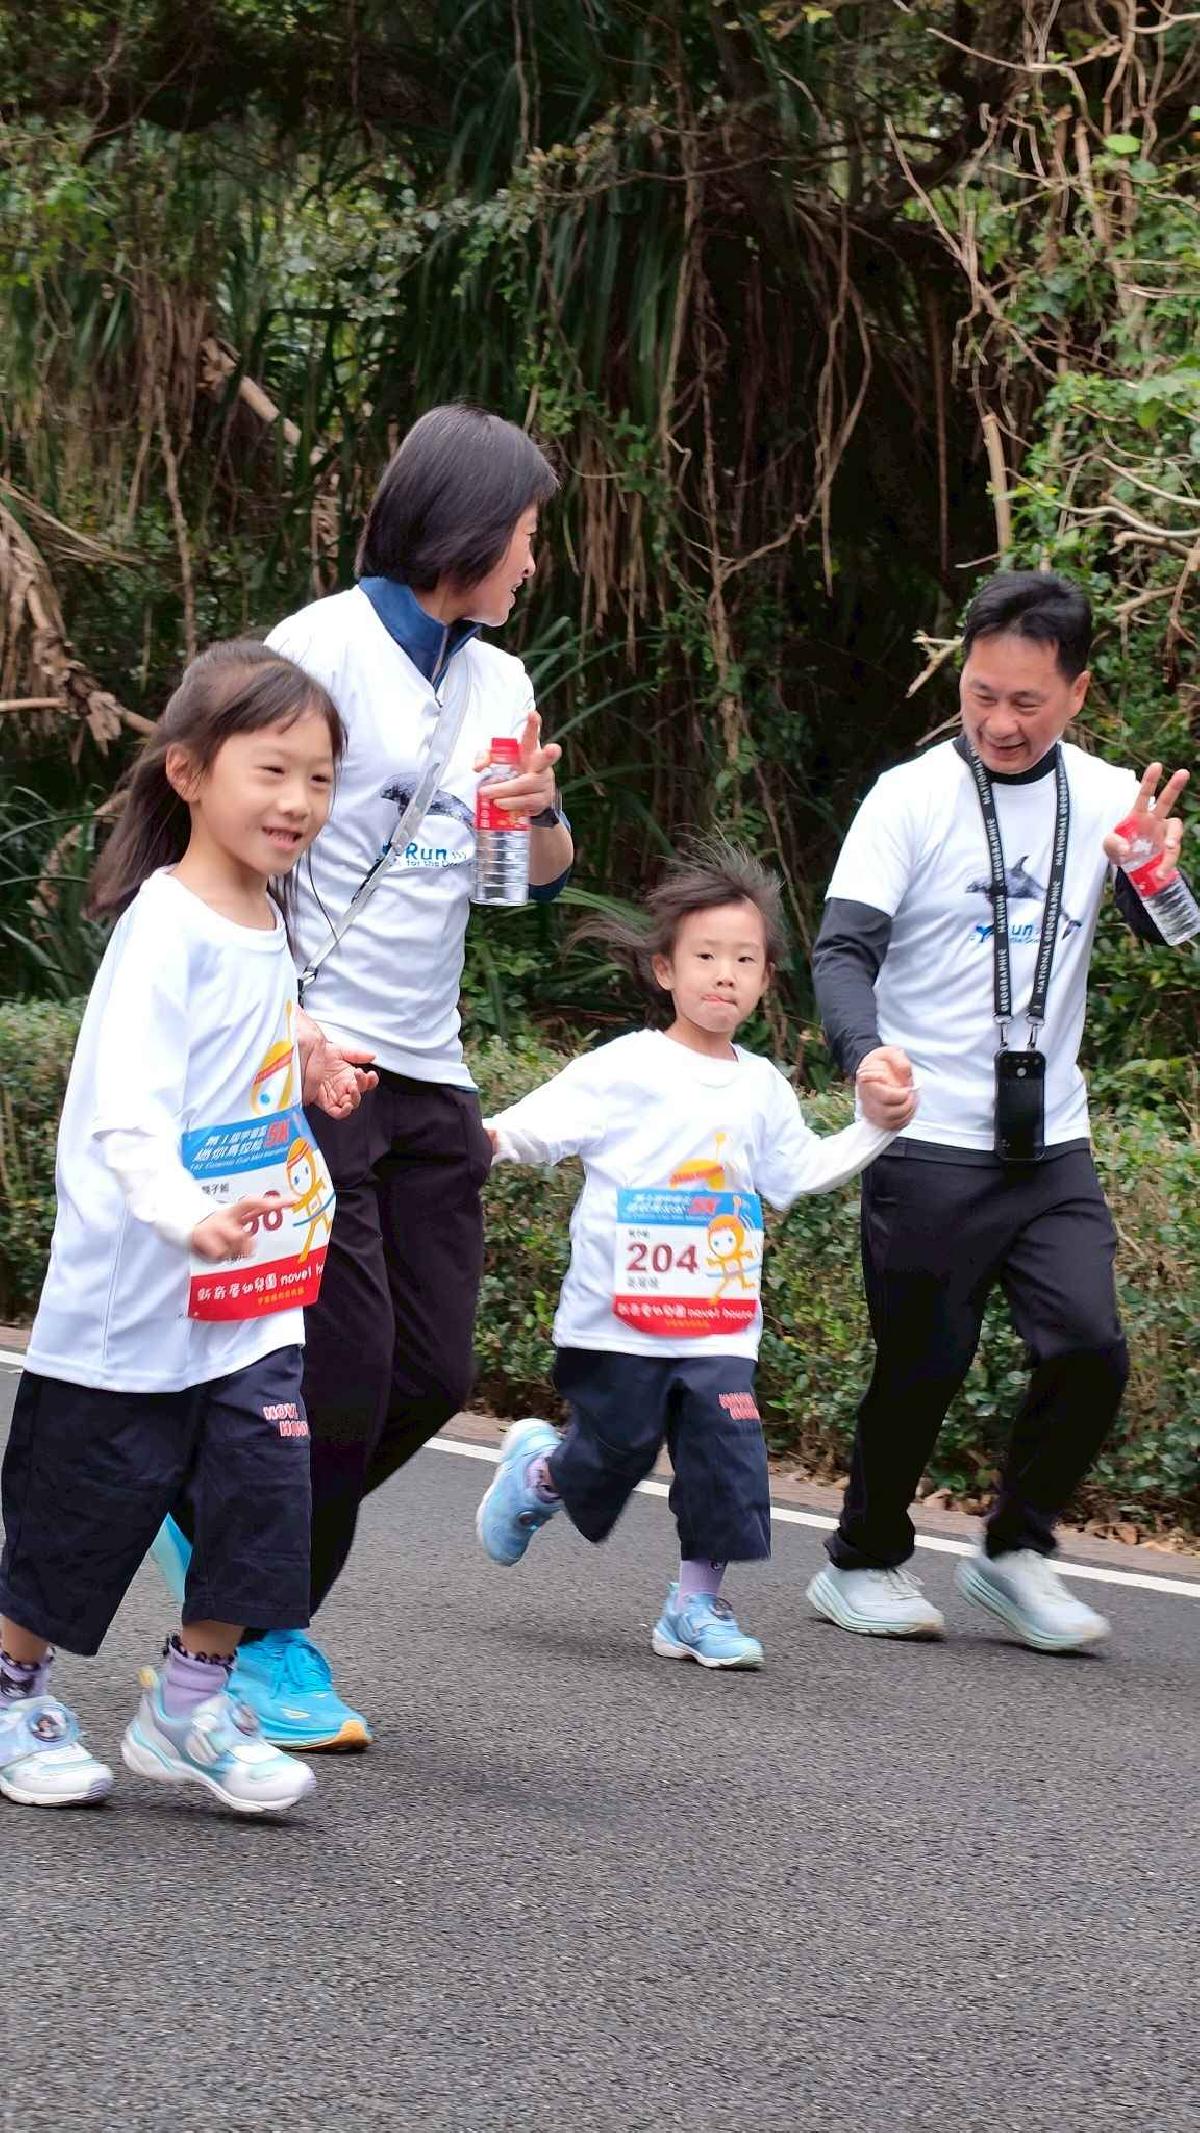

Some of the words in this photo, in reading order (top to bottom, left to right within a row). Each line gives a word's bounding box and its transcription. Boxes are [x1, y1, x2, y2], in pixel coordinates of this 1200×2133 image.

[405, 842, 447, 861] Run
[986, 817, 1004, 882] GEOGRAPHIC
[1055, 816, 1070, 867] NATIONAL
[1043, 881, 1062, 943] GEOGRAPHIC
[997, 948, 1010, 1012] GEOGRAPHIC
[1037, 943, 1053, 994] NATIONAL
[281, 1269, 311, 1287] novel
[627, 1242, 698, 1273] 204
